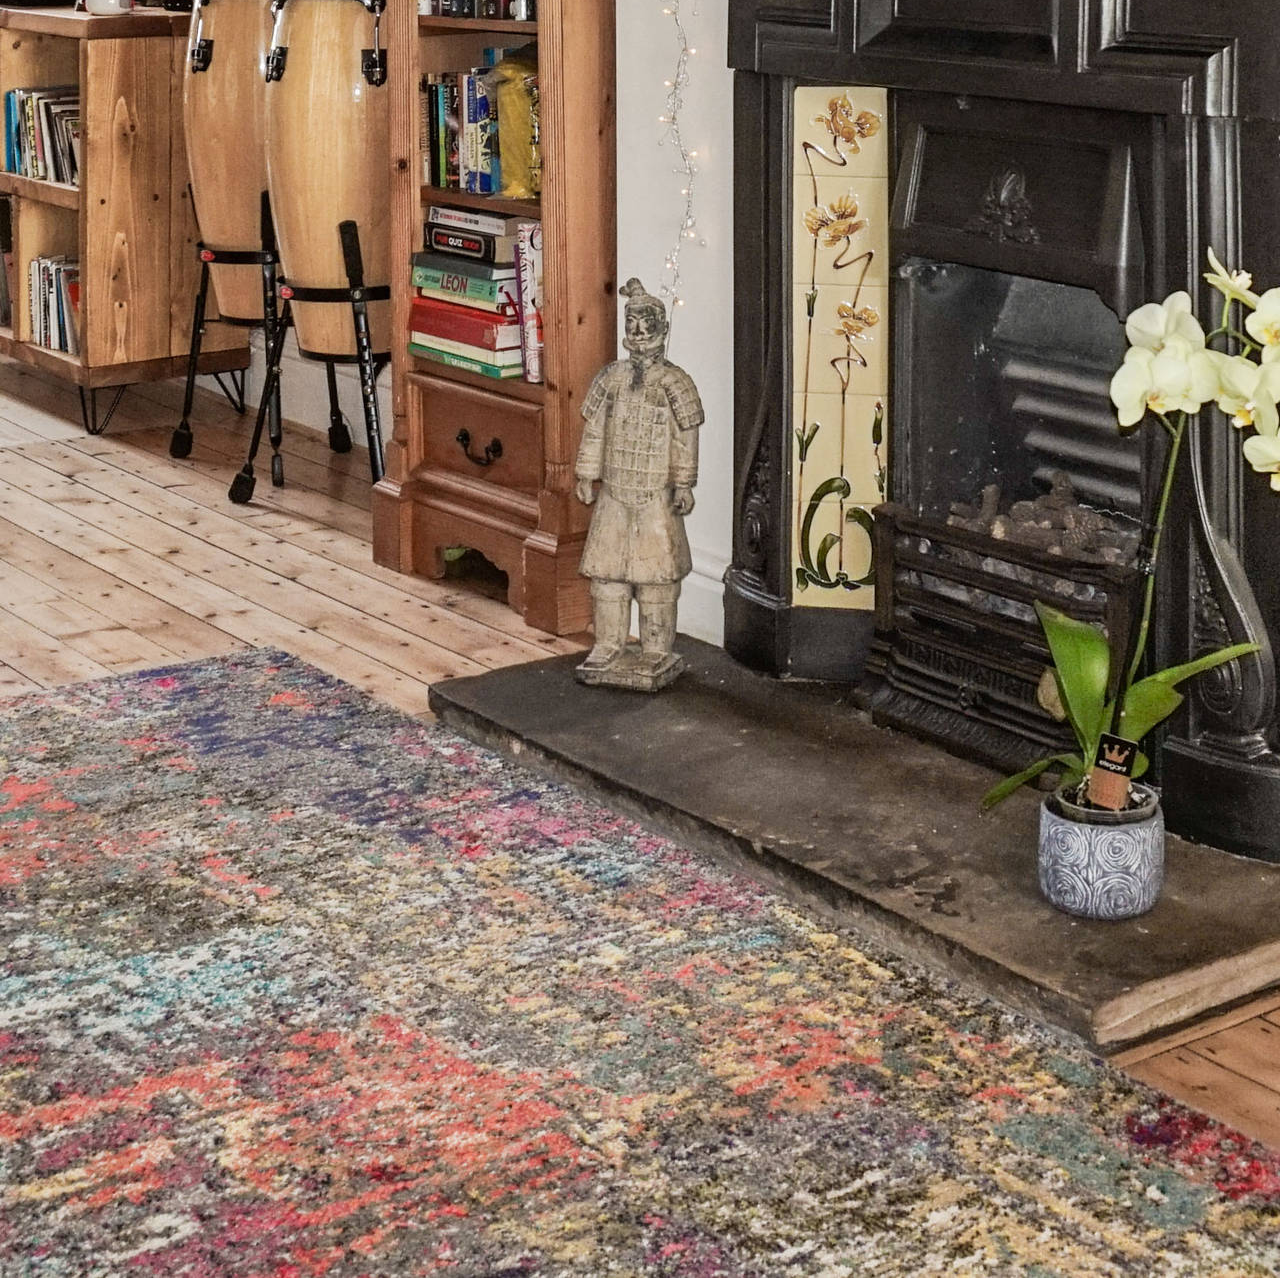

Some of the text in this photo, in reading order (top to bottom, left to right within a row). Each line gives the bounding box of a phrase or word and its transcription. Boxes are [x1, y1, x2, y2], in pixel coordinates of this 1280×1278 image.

[448, 236, 463, 248] QUIZ
[440, 274, 469, 294] LEON
[1098, 759, 1127, 773] elegant
